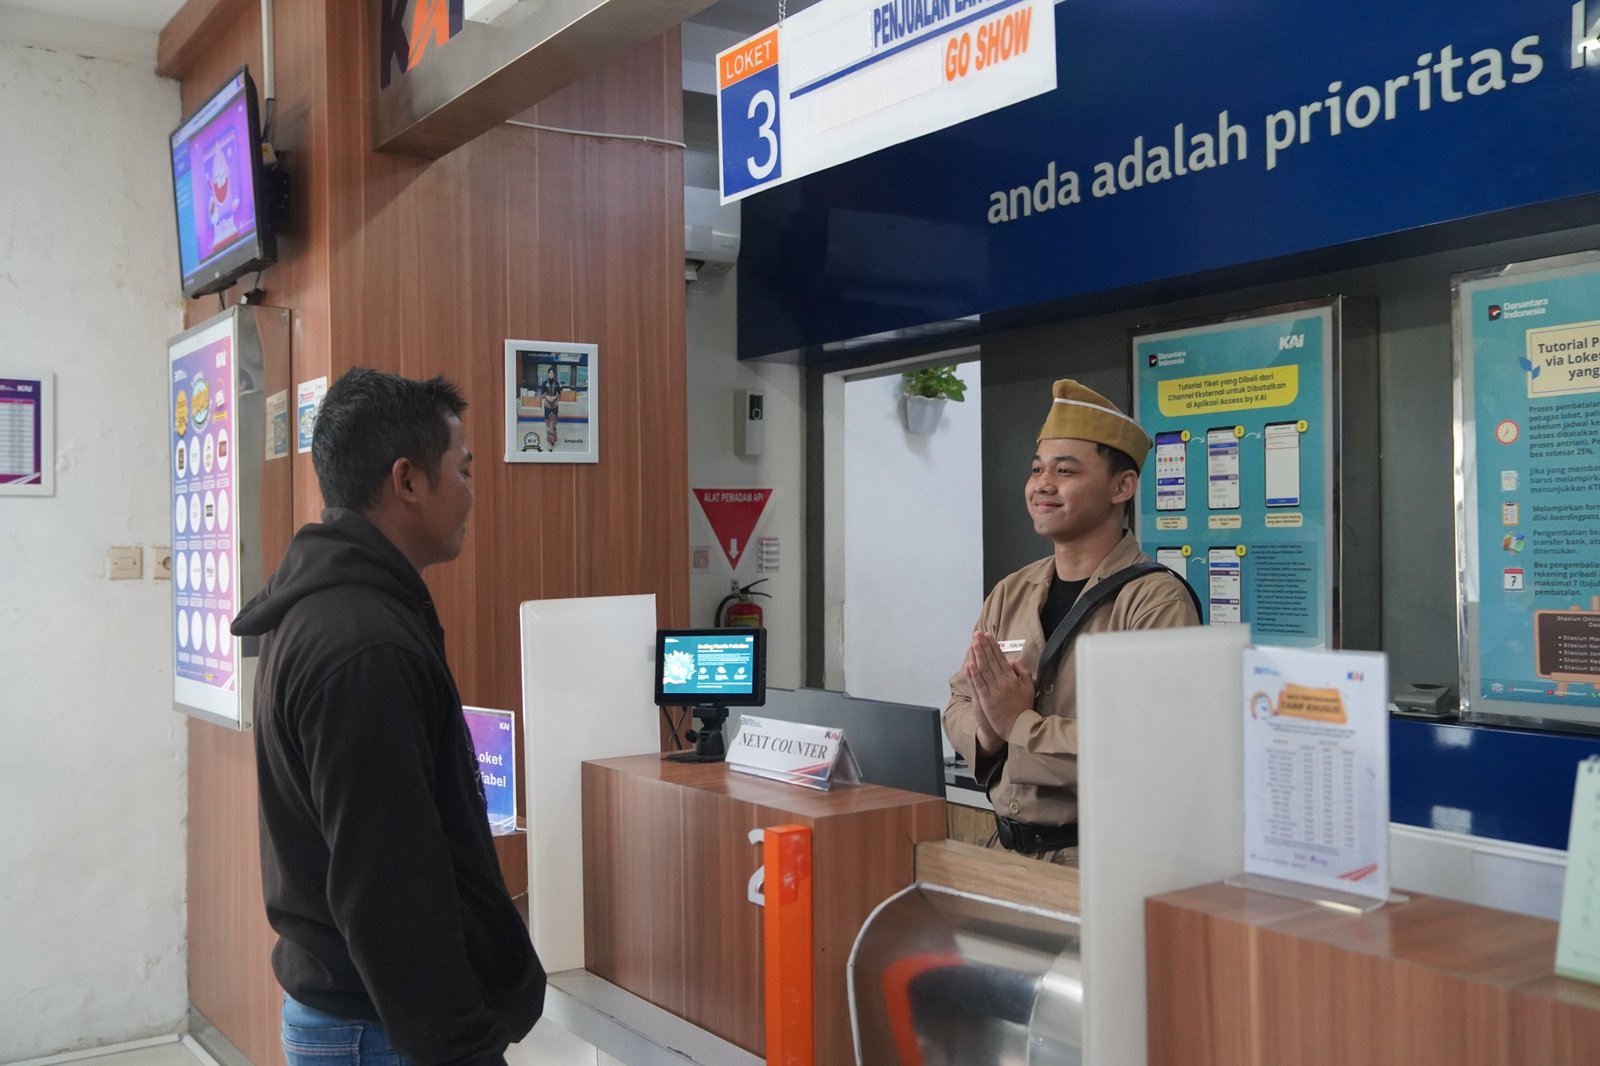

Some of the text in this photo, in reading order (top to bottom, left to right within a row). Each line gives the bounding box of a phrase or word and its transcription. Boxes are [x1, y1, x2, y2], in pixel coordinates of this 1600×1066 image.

[945, 6, 1032, 81] GO SHOW
[726, 39, 772, 79] LOKET
[747, 89, 778, 180] 3
[987, 161, 1081, 224] anda
[1091, 110, 1248, 199] adalah
[1265, 35, 1544, 171] prioritas
[1504, 298, 1548, 311] Danantara
[1504, 307, 1546, 319] Indonesia
[1279, 334, 1304, 350] KAI
[1538, 337, 1588, 354] Tutorial
[1545, 355, 1564, 367] via
[1568, 367, 1600, 382] yang
[1178, 373, 1274, 391] Tutorial Tiket yang Dibeli dari
[1168, 382, 1286, 401] Channel Eksternal untuk Dibatalkan
[1186, 394, 1267, 409] di Aplikasi Access by KAI
[1529, 415, 1559, 423] petugas
[1529, 423, 1562, 431] sebelum
[1562, 420, 1589, 430] jadwal
[1529, 442, 1554, 450] proses
[1546, 467, 1565, 476] yang
[1530, 485, 1586, 494] menunjukkan
[704, 493, 720, 502] ALAT
[1533, 504, 1584, 512] Melampirkan
[1533, 529, 1588, 538] Pengembalian
[1534, 561, 1548, 569] Bea
[1534, 570, 1598, 579] rekening pribadi
[1510, 575, 1517, 587] 7
[739, 732, 828, 760] NEXT COUNTER
[477, 752, 503, 766] oket
